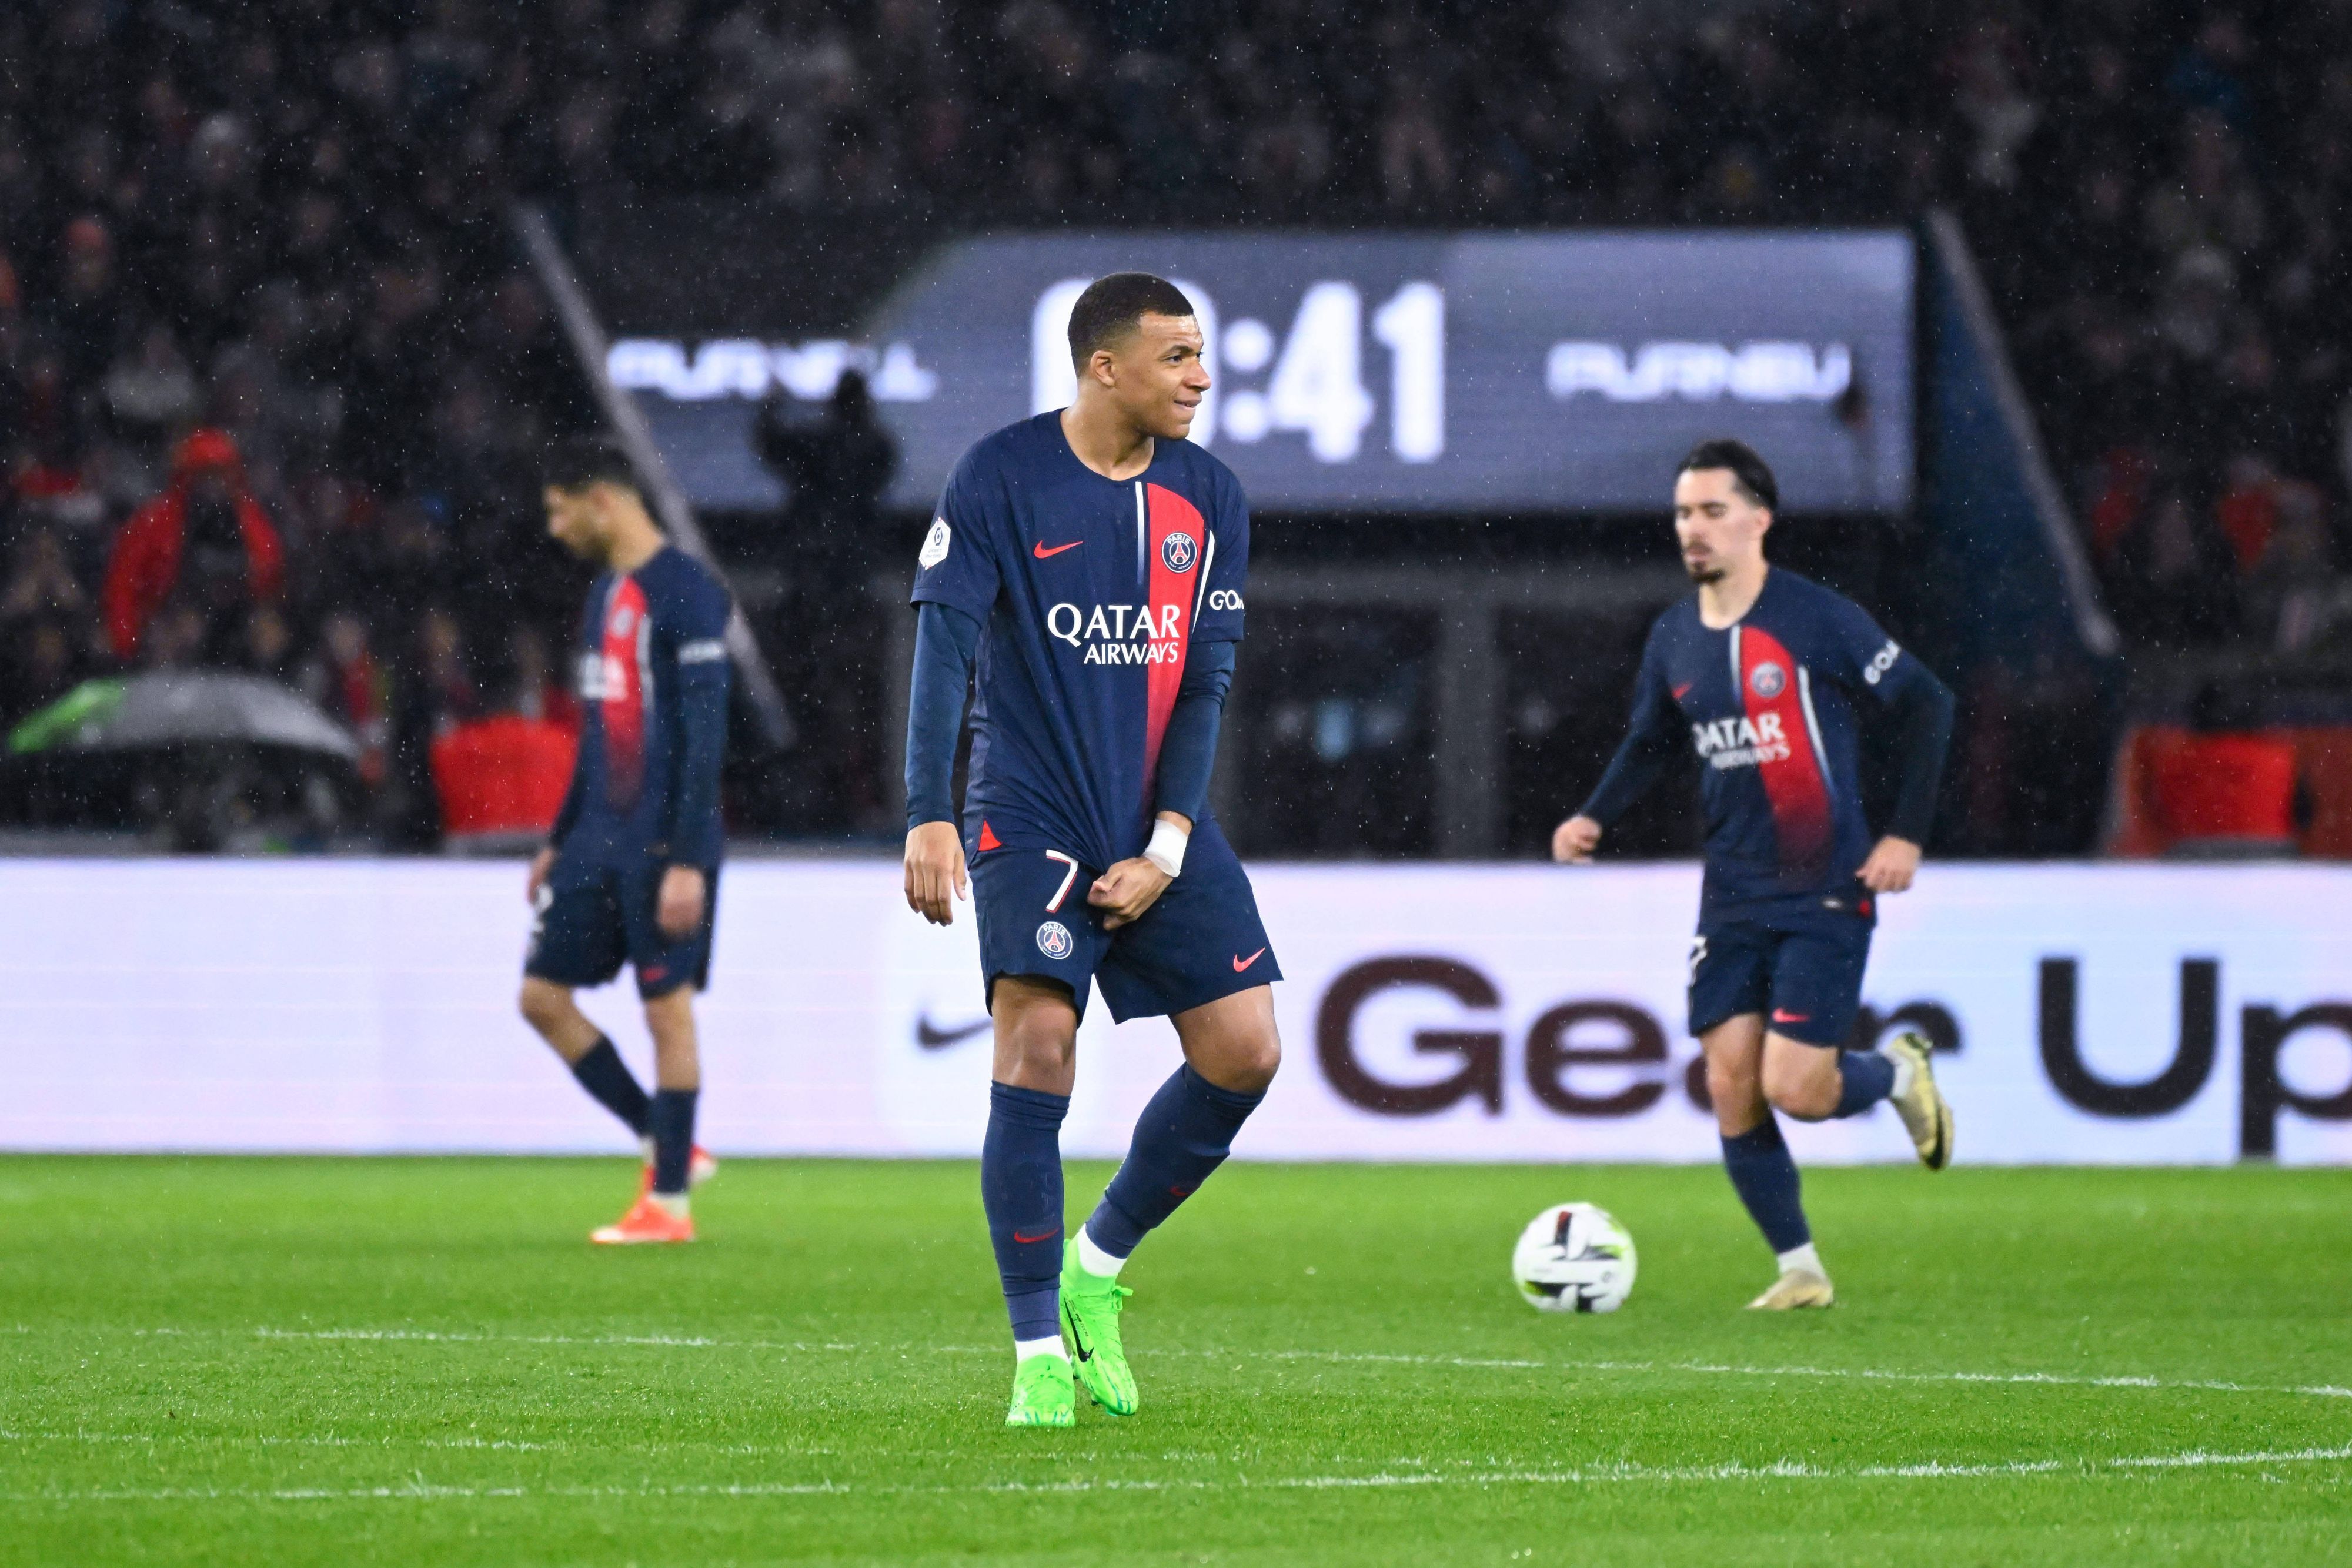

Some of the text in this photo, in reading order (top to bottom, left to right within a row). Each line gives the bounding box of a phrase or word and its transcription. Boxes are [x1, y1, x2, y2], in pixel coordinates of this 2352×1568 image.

[1167, 534, 1190, 544] PARIS
[1047, 603, 1181, 647] QATAR
[1083, 641, 1179, 664] AIRWAYS
[1045, 848, 1079, 914] 7
[1043, 924, 1066, 935] PARIS
[1315, 954, 2352, 1157] Ger Up
